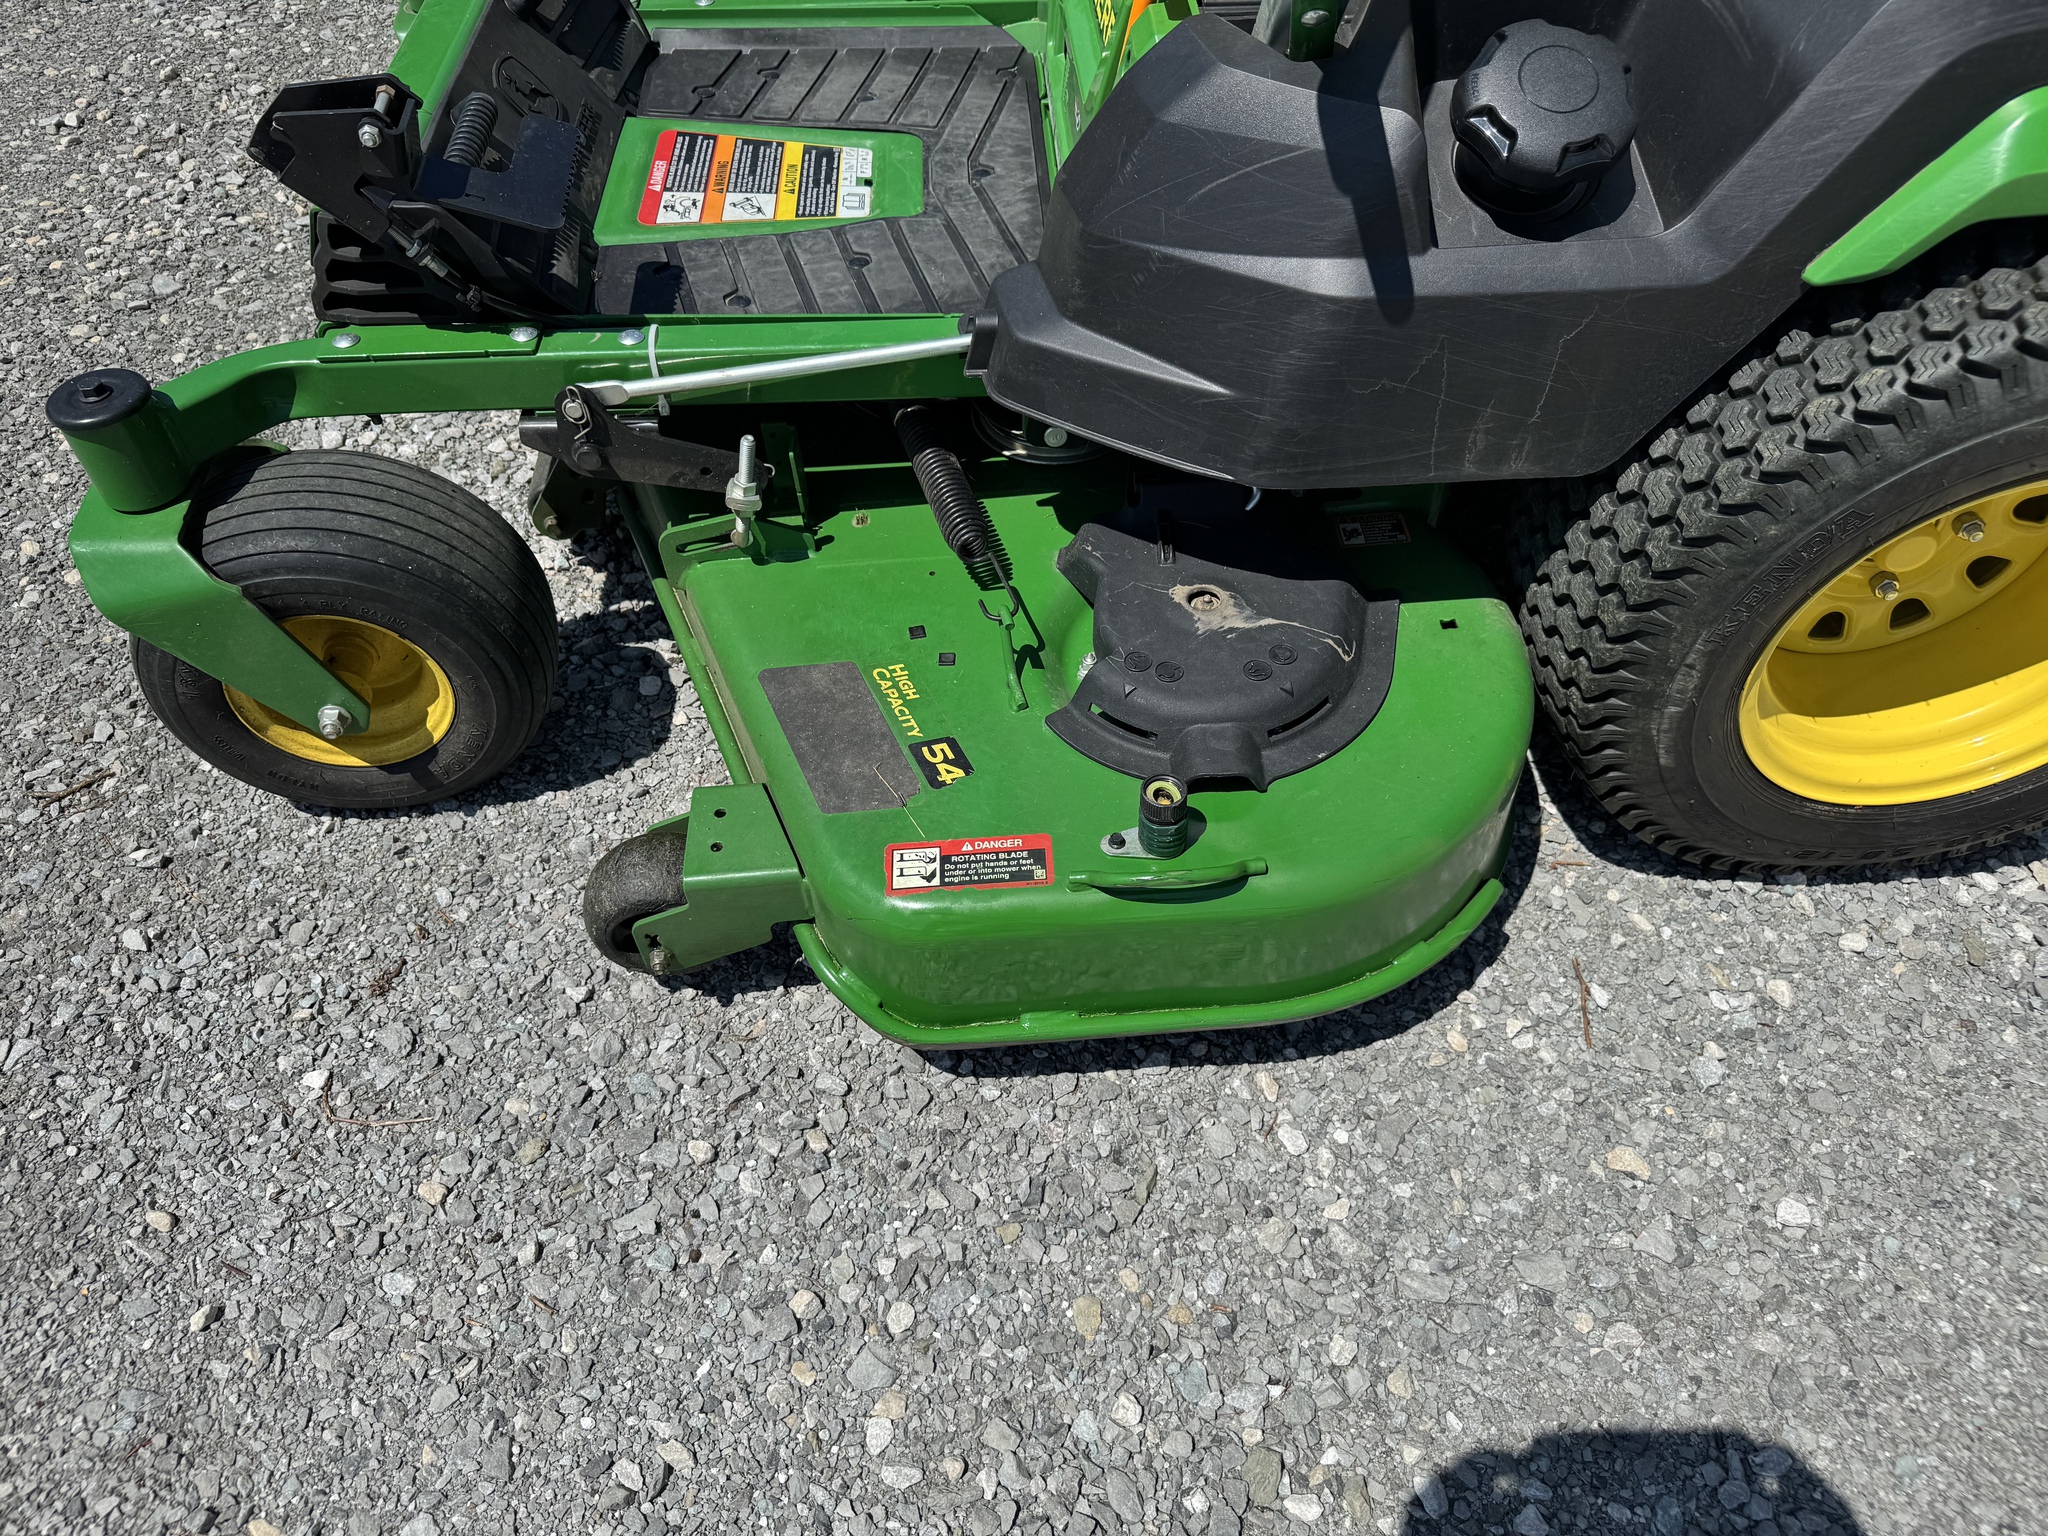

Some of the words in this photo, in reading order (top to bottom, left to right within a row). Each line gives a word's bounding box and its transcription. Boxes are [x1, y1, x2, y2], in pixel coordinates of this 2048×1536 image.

[652, 160, 668, 185] DANGER
[714, 160, 730, 187] WARNING
[784, 163, 799, 188] CAUTION
[1705, 507, 1877, 647] KENDA
[888, 663, 920, 700] HIGH
[872, 667, 924, 738] CAPACITY
[432, 721, 490, 779] KENDA
[921, 742, 966, 785] 54
[951, 853, 997, 862] ROTATING
[999, 851, 1029, 859] BLADE
[975, 839, 1022, 850] DANGER
[972, 862, 983, 871] put
[980, 872, 1009, 880] running
